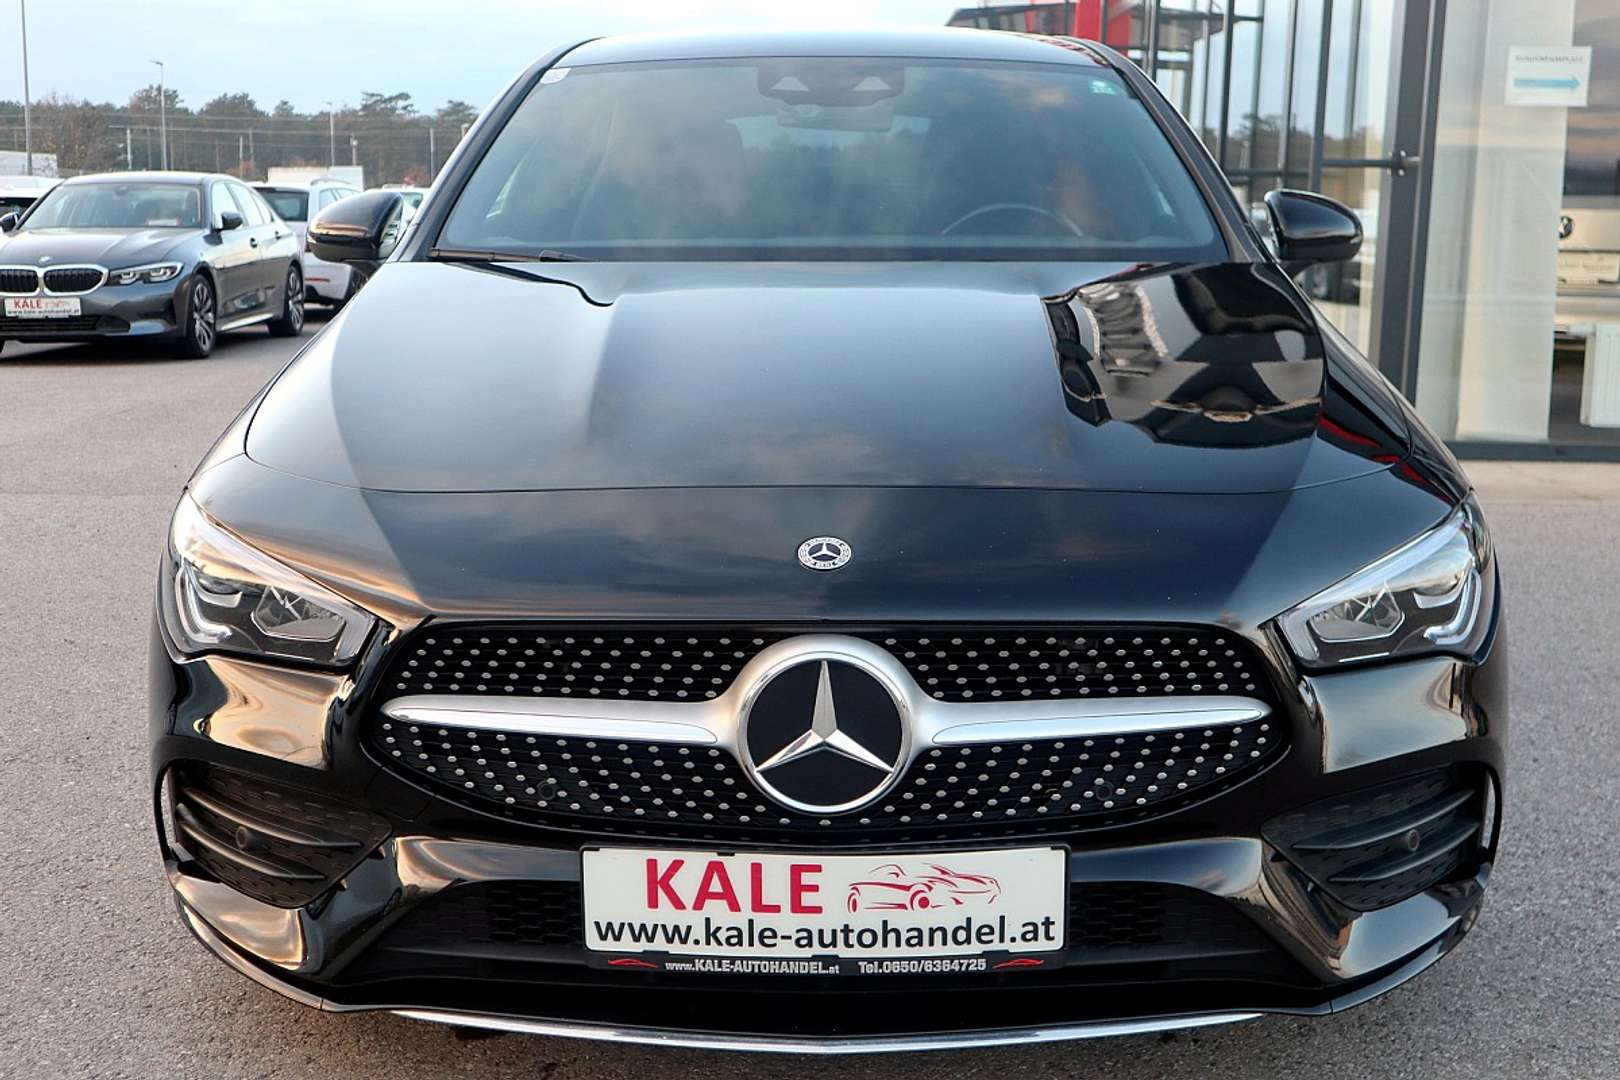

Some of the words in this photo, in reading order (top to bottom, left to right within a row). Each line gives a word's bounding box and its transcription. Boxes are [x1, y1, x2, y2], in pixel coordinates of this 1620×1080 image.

[14, 299, 43, 309] KALE
[647, 859, 823, 913] KALE
[593, 916, 1056, 949] www.kale-autohandel.at
[665, 959, 840, 975] www.KALE-AUTOHANDEL.at
[858, 959, 987, 974] Tel.0650/6364725
